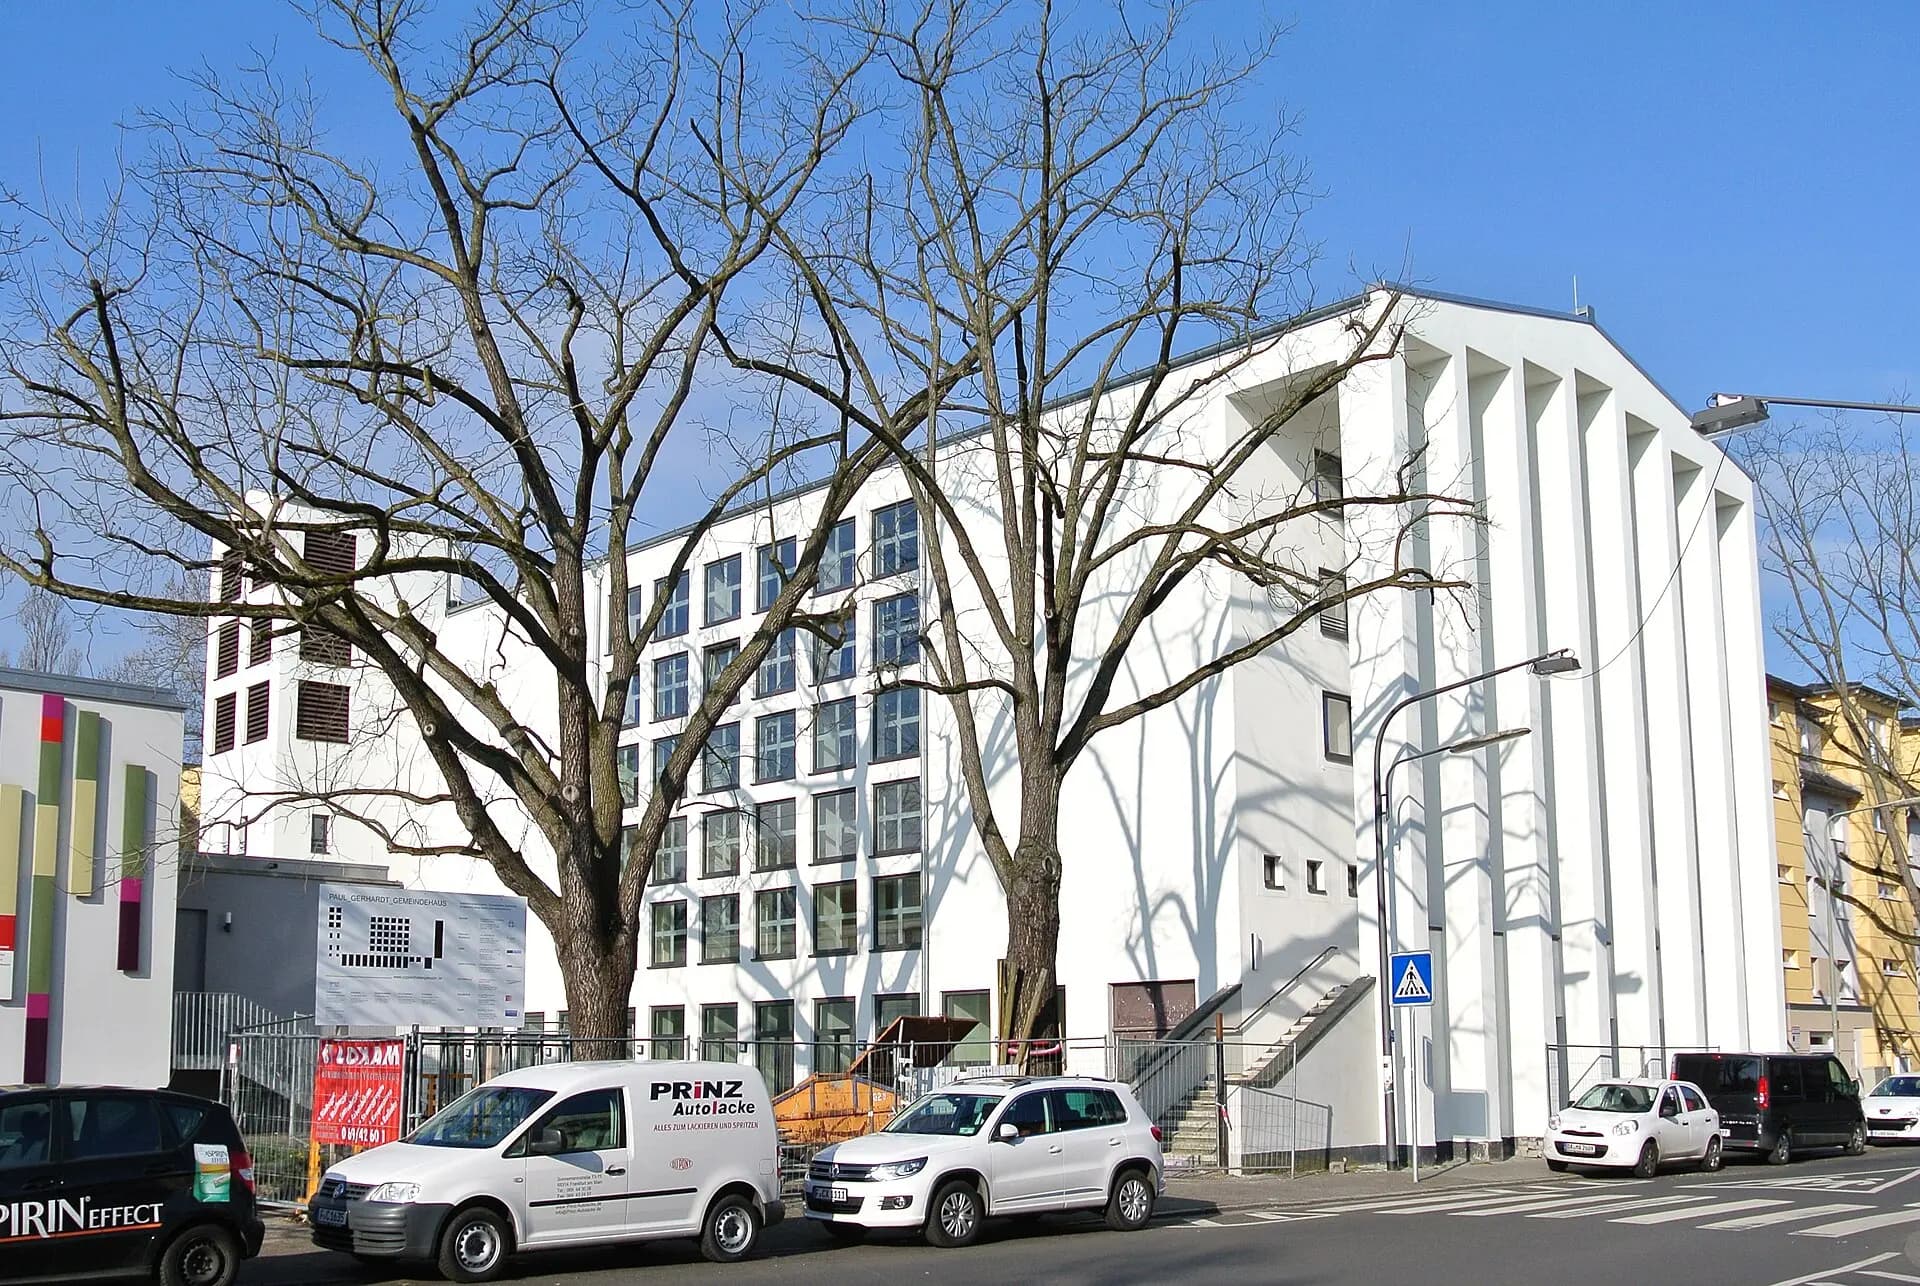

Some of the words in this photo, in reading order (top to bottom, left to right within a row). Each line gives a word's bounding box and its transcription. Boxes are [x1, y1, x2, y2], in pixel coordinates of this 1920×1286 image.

[335, 1045, 400, 1065] LOXAM
[672, 1100, 755, 1116] Autolacke
[653, 1124, 672, 1132] ALLES
[673, 1123, 686, 1131] ZUM
[687, 1122, 719, 1131] LACKIEREN
[720, 1121, 732, 1129] UND
[733, 1121, 759, 1129] SPRITZEN
[89, 1203, 164, 1229] EFFECT
